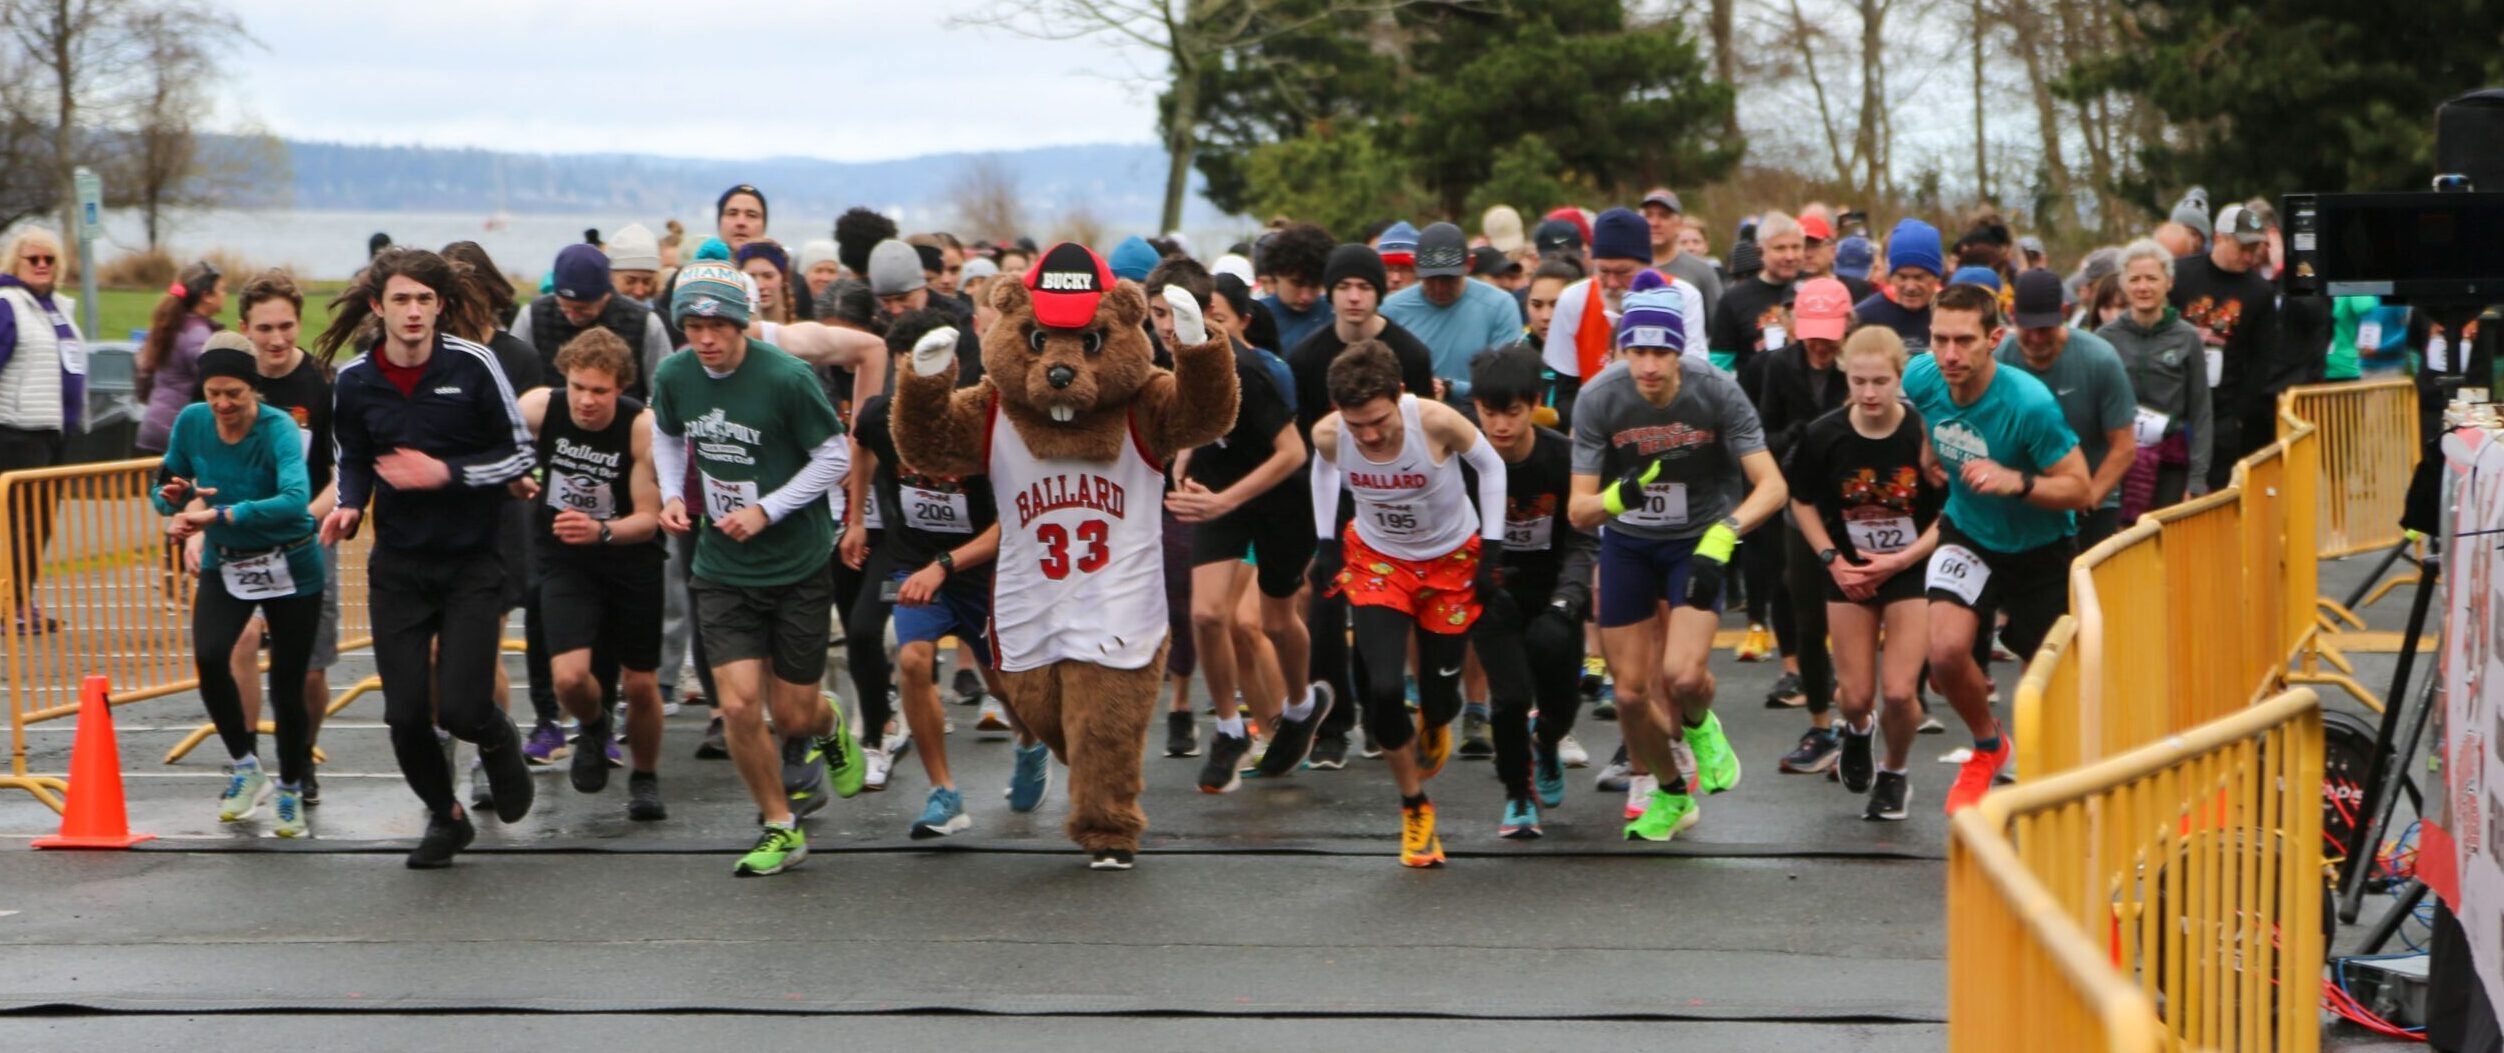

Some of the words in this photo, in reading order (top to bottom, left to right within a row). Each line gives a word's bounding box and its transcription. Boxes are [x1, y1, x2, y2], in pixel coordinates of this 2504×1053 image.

[1041, 272, 1092, 290] BUCKY
[722, 421, 763, 446] POLY
[555, 437, 621, 468] Ballard
[1349, 472, 1427, 490] BALLARD
[560, 486, 598, 510] 208
[711, 491, 747, 514] 125
[1015, 473, 1125, 529] BALLARD
[914, 502, 956, 522] 209
[1374, 513, 1417, 529] 195
[1036, 519, 1110, 581] 33
[1864, 529, 1908, 550] 122
[233, 568, 276, 586] 221
[1939, 557, 1968, 580] 66
